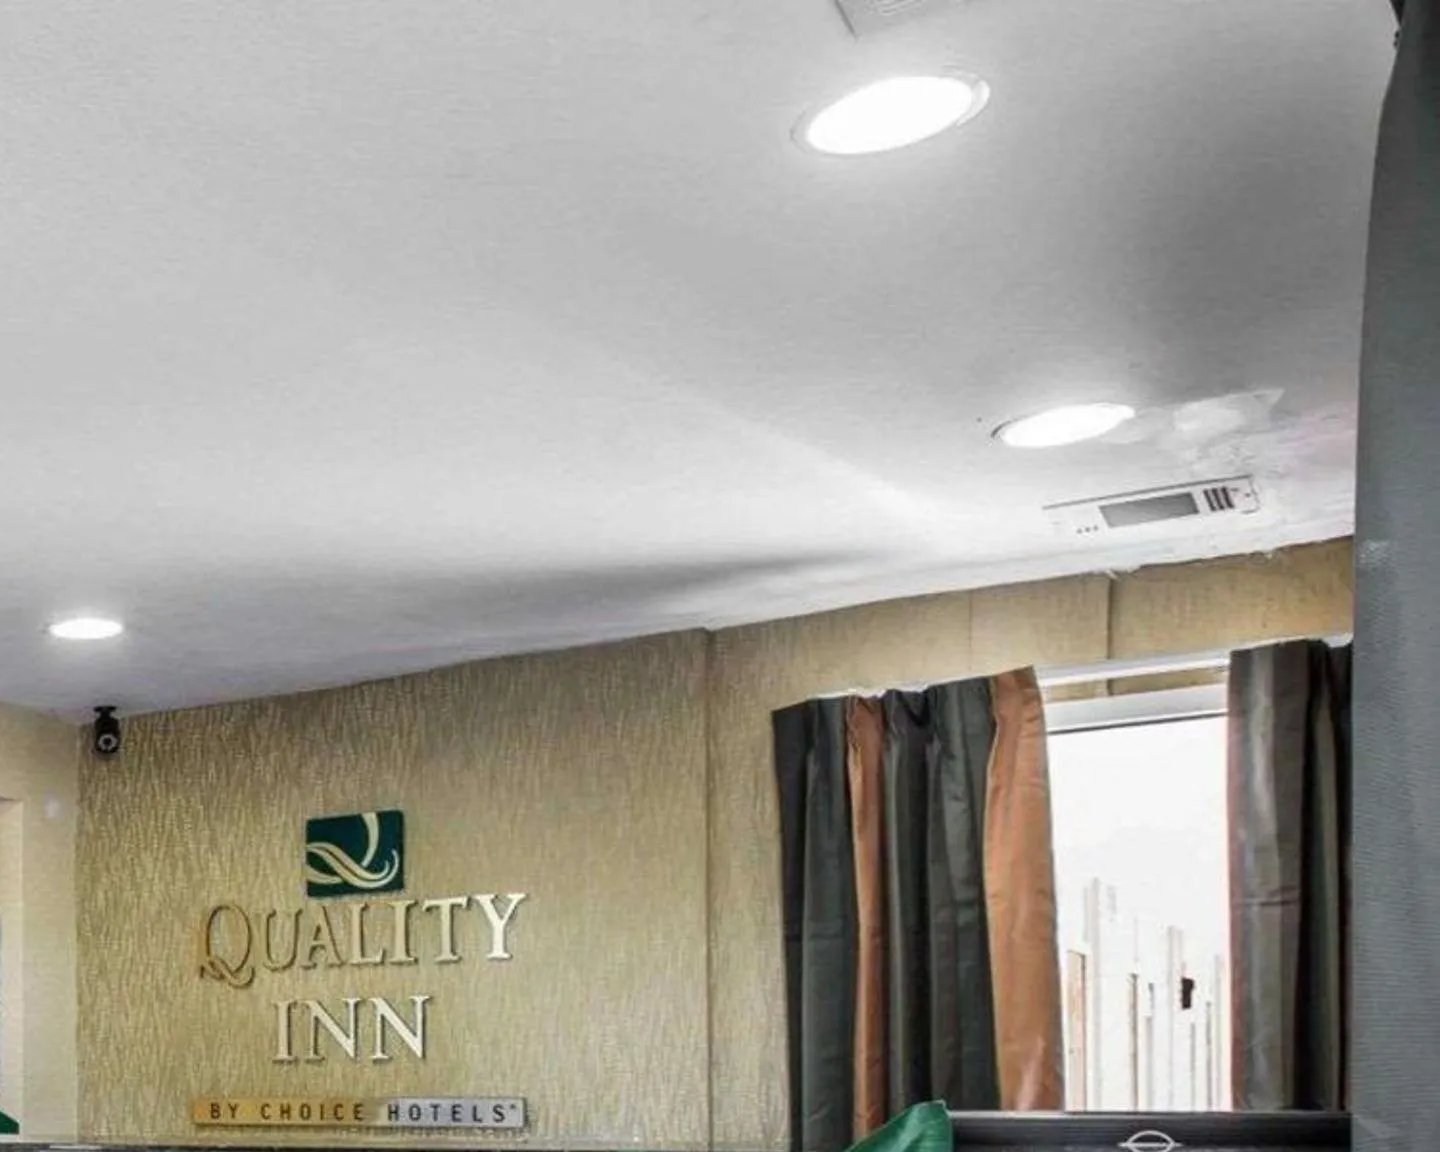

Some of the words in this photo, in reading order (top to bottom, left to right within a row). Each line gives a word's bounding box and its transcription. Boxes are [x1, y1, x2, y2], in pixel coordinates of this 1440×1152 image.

[200, 892, 526, 988] QUALITY
[272, 995, 431, 1063] INN
[210, 1104, 239, 1120] BY
[261, 1103, 365, 1121] CHOICE
